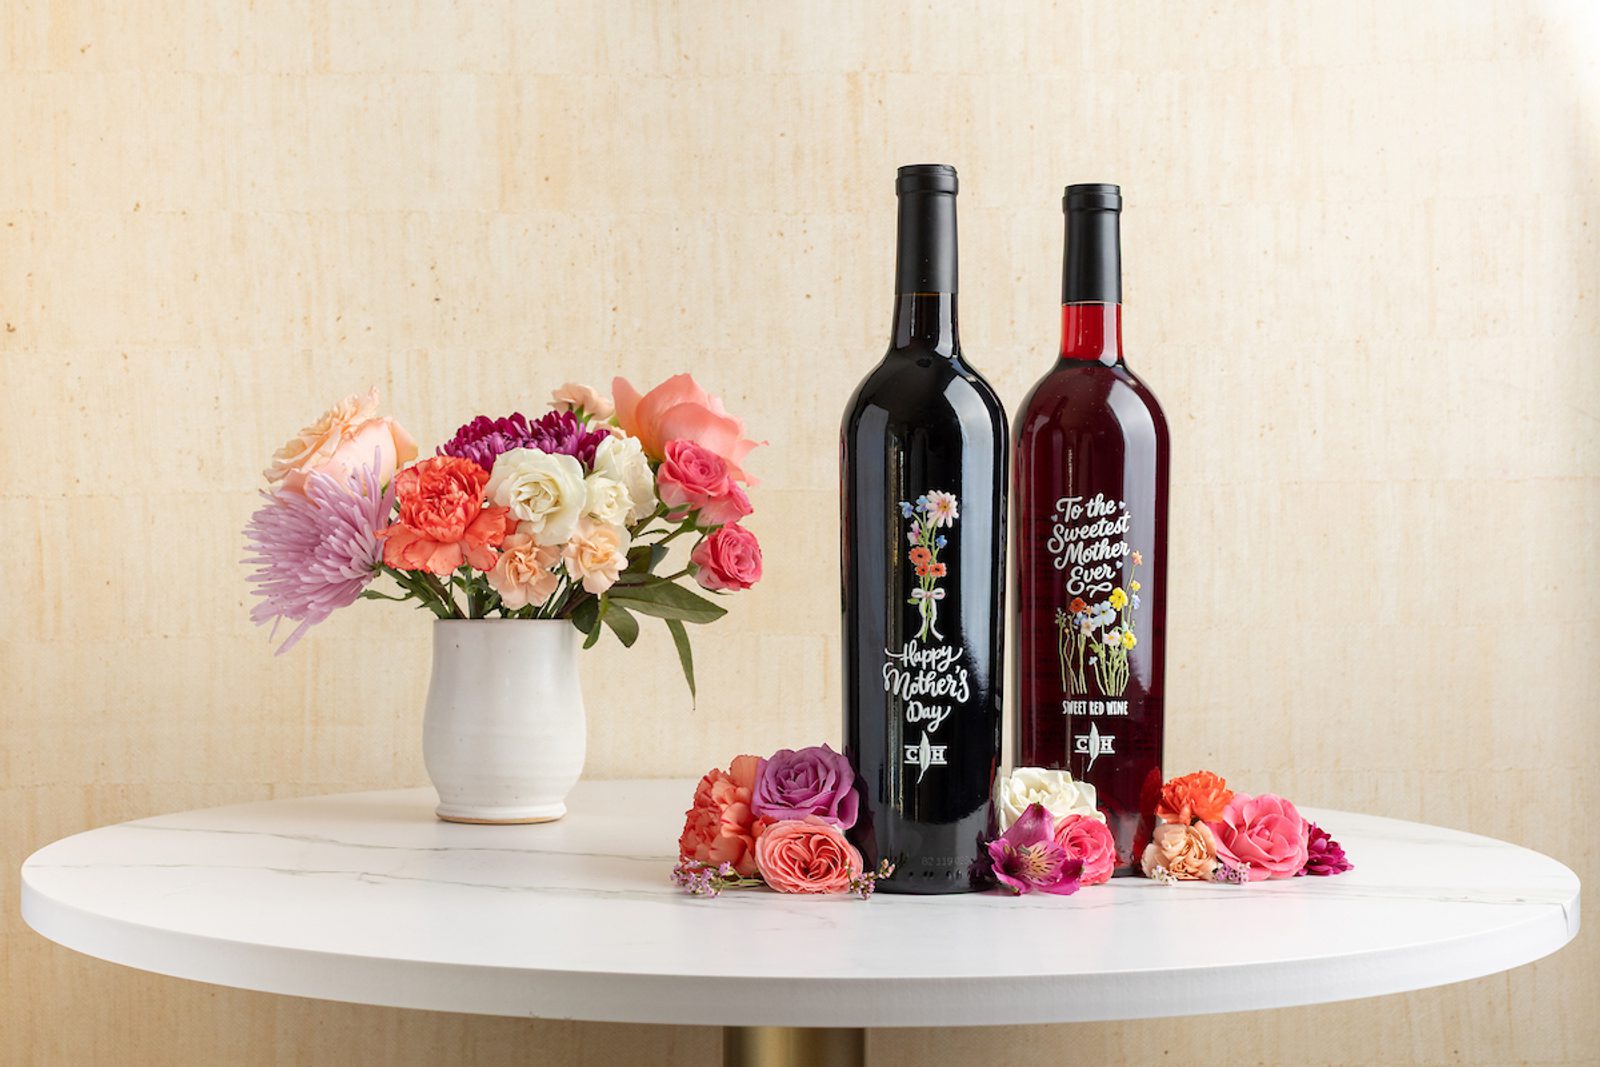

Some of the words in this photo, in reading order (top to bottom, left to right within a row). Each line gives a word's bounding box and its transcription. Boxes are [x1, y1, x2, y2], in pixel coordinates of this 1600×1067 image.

[1056, 496, 1084, 523] To
[1085, 492, 1117, 518] the
[1047, 511, 1131, 553] Sweetest
[1054, 538, 1130, 570] Mother
[1066, 563, 1116, 595] Ever
[884, 639, 963, 672] Happy
[883, 662, 970, 703] Mother's
[906, 700, 952, 733] Day
[1062, 700, 1087, 715] SWEET
[1089, 700, 1105, 715] RED
[1106, 700, 1129, 715] WINE
